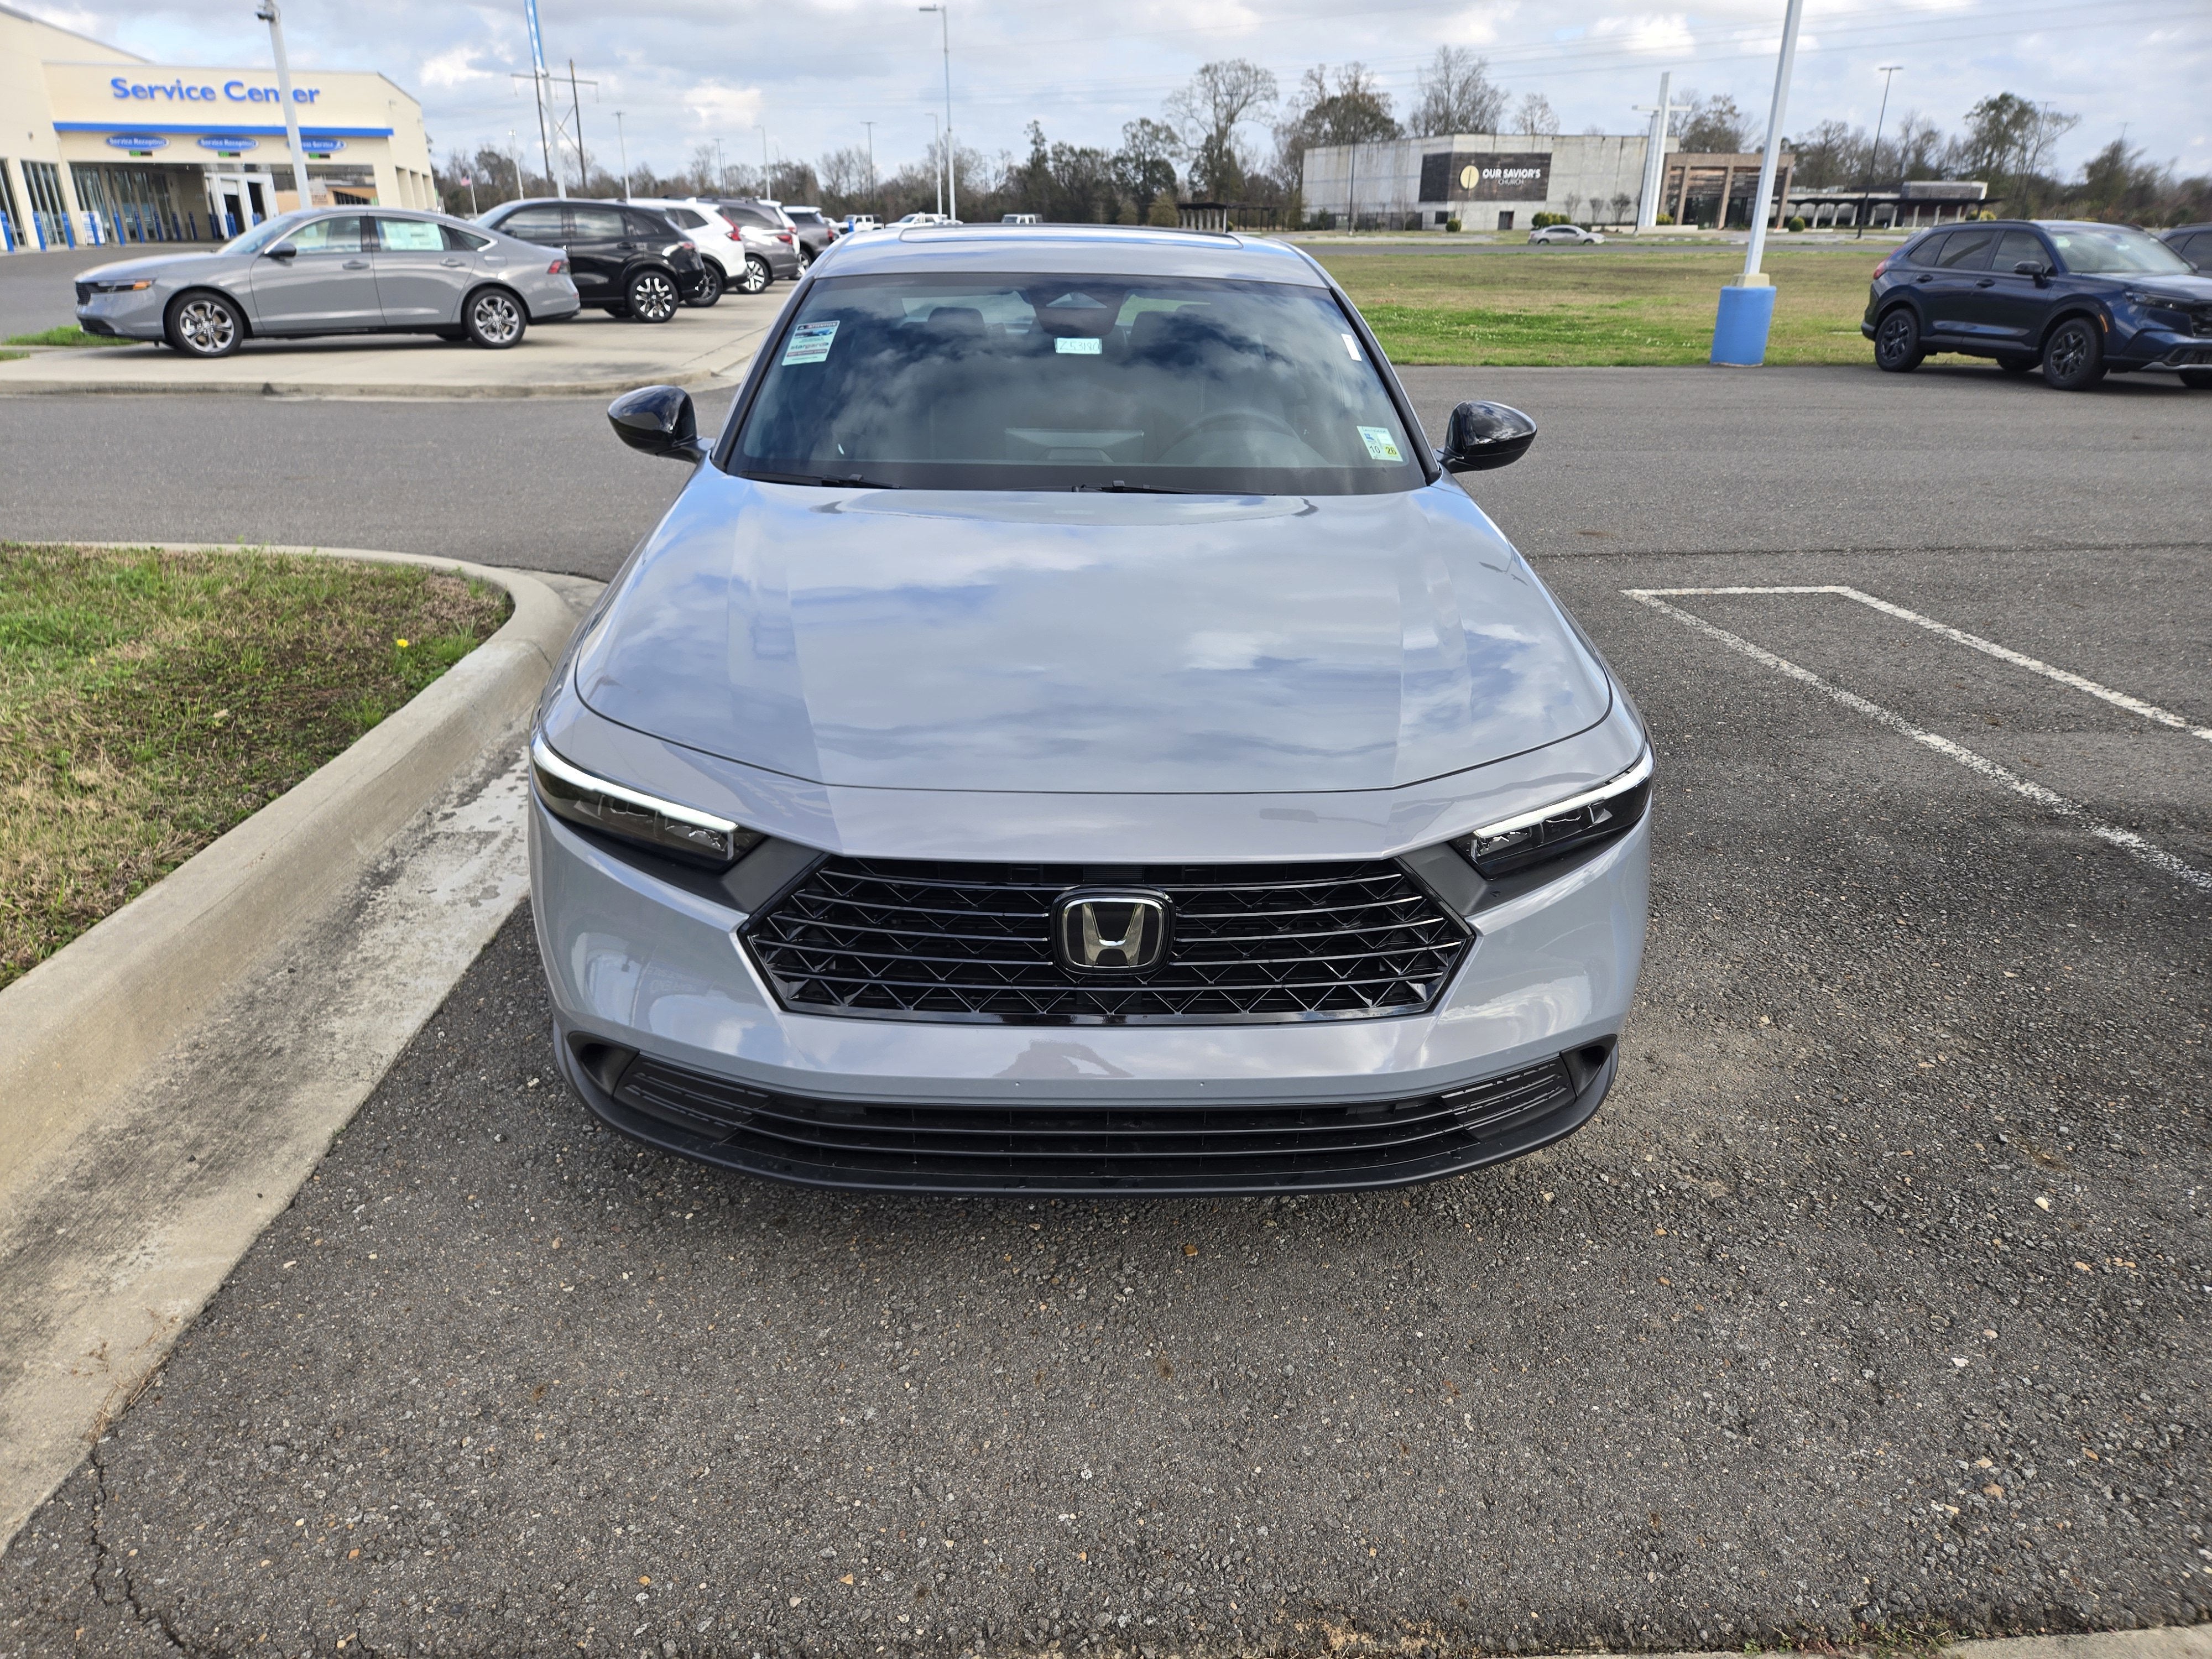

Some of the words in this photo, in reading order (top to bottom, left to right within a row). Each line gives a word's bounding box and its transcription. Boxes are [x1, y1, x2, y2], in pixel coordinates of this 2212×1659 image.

[111, 77, 216, 101] Service
[224, 80, 320, 103] Cener
[1482, 168, 1502, 179] OUR
[1503, 168, 1541, 179] SAVIOR'S
[1369, 445, 1380, 453] 10
